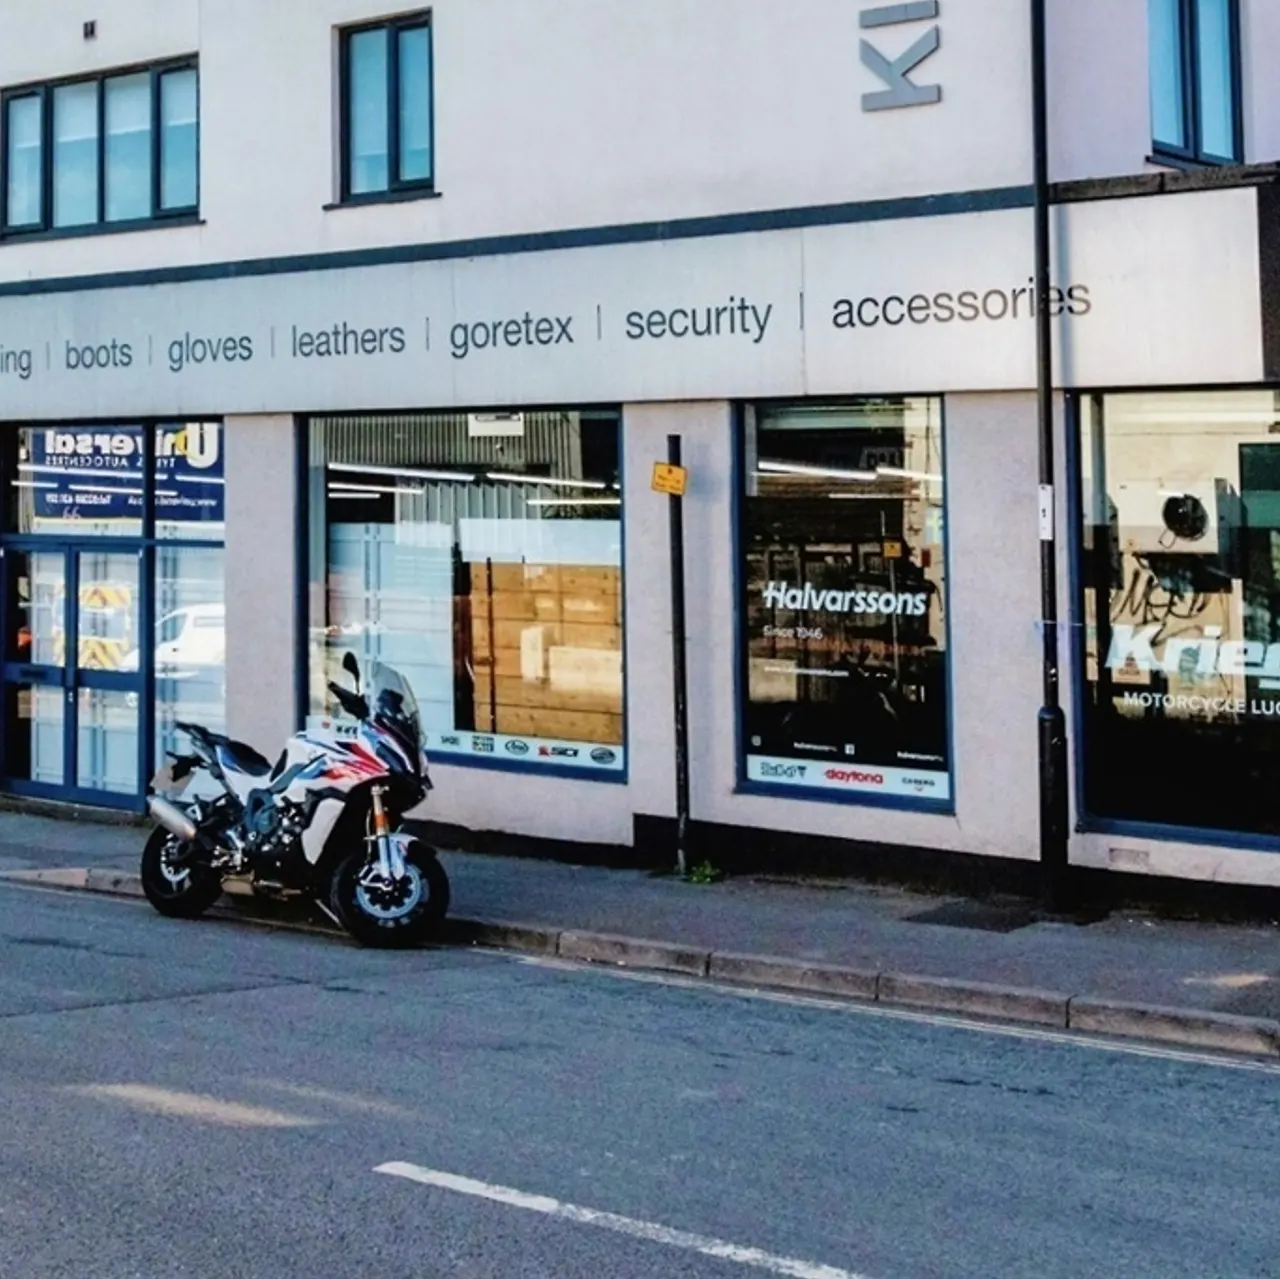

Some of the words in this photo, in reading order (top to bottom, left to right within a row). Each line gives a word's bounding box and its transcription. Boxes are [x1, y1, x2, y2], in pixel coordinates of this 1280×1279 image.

[65, 338, 133, 371] boots
[167, 331, 253, 372] gloves
[291, 322, 406, 357] leathers
[450, 311, 575, 359] goretex
[625, 295, 773, 343] security
[832, 276, 1092, 329] accessories
[763, 581, 927, 616] Halvarssons
[763, 625, 794, 639] Since
[1123, 691, 1247, 714] MOTORCYCLE
[825, 768, 884, 786] daytona
